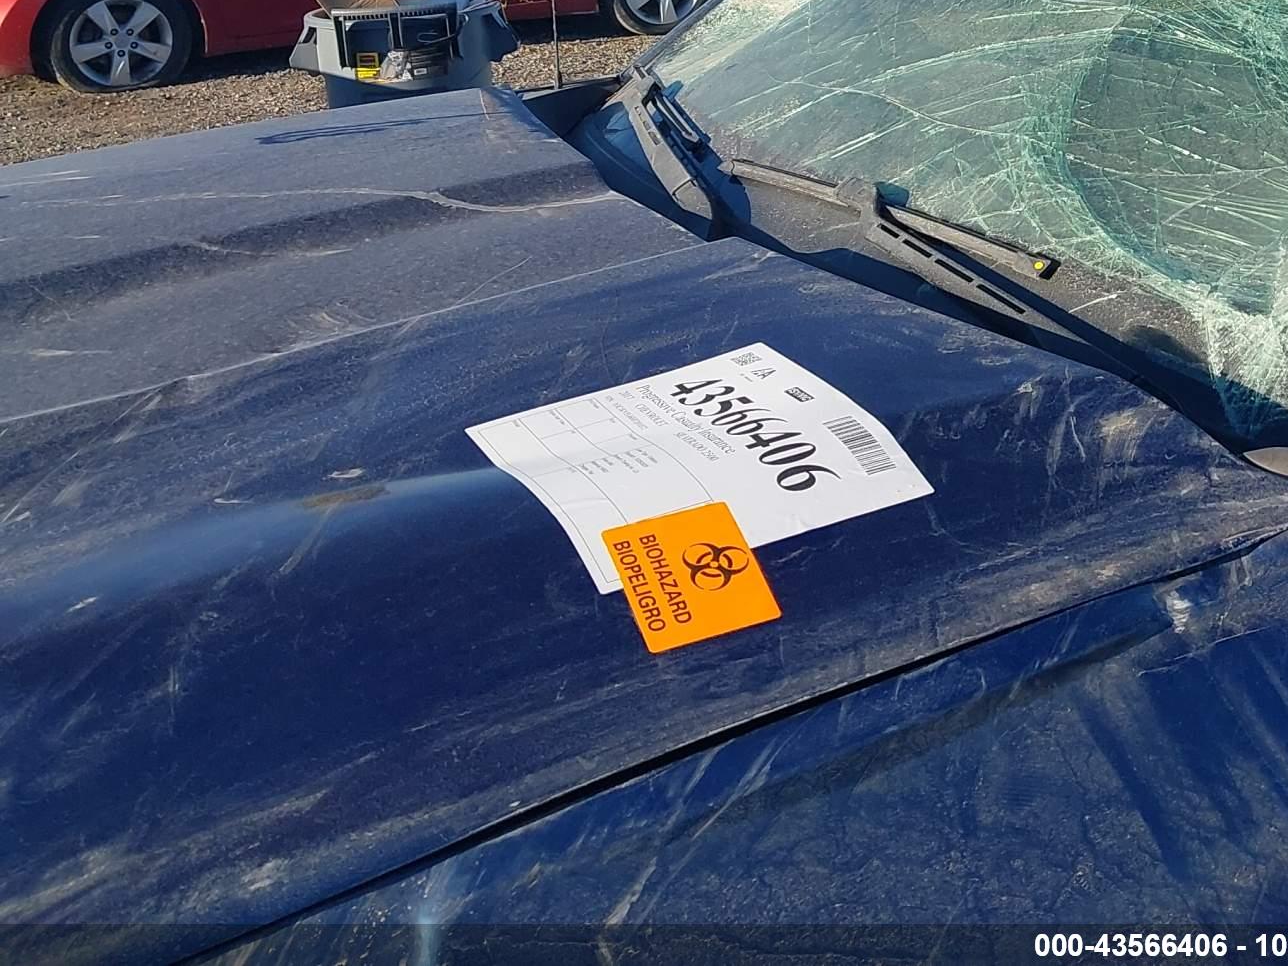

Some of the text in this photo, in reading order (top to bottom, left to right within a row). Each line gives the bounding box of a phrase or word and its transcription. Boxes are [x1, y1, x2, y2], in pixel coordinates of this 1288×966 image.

[670, 379, 841, 491] 43566406
[699, 428, 735, 454] Insurance
[613, 540, 666, 632] BIOPELIGRO
[639, 534, 692, 624] BIOHAZARD
